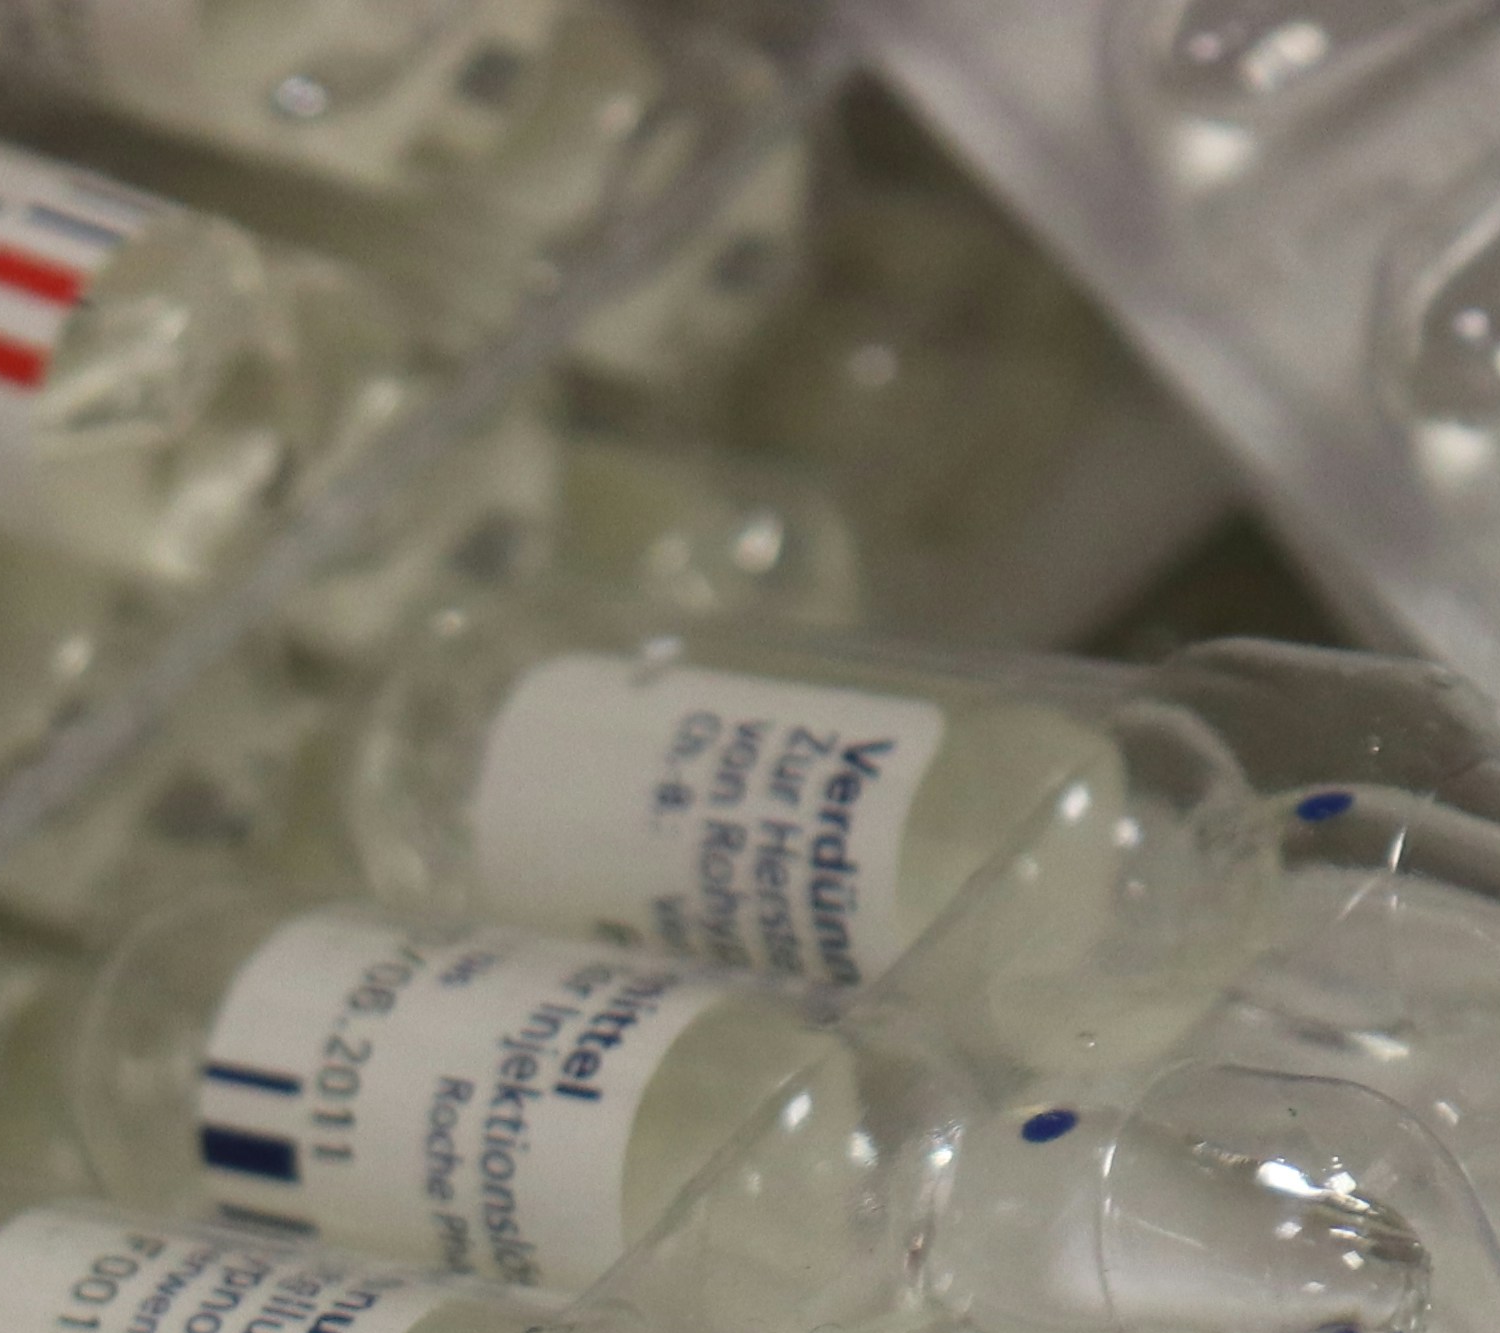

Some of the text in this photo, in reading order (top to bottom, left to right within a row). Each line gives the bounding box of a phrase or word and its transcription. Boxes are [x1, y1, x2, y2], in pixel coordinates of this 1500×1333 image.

[708, 718, 774, 805] von
[770, 725, 838, 804] Zur
[425, 1074, 476, 1204] Roche
